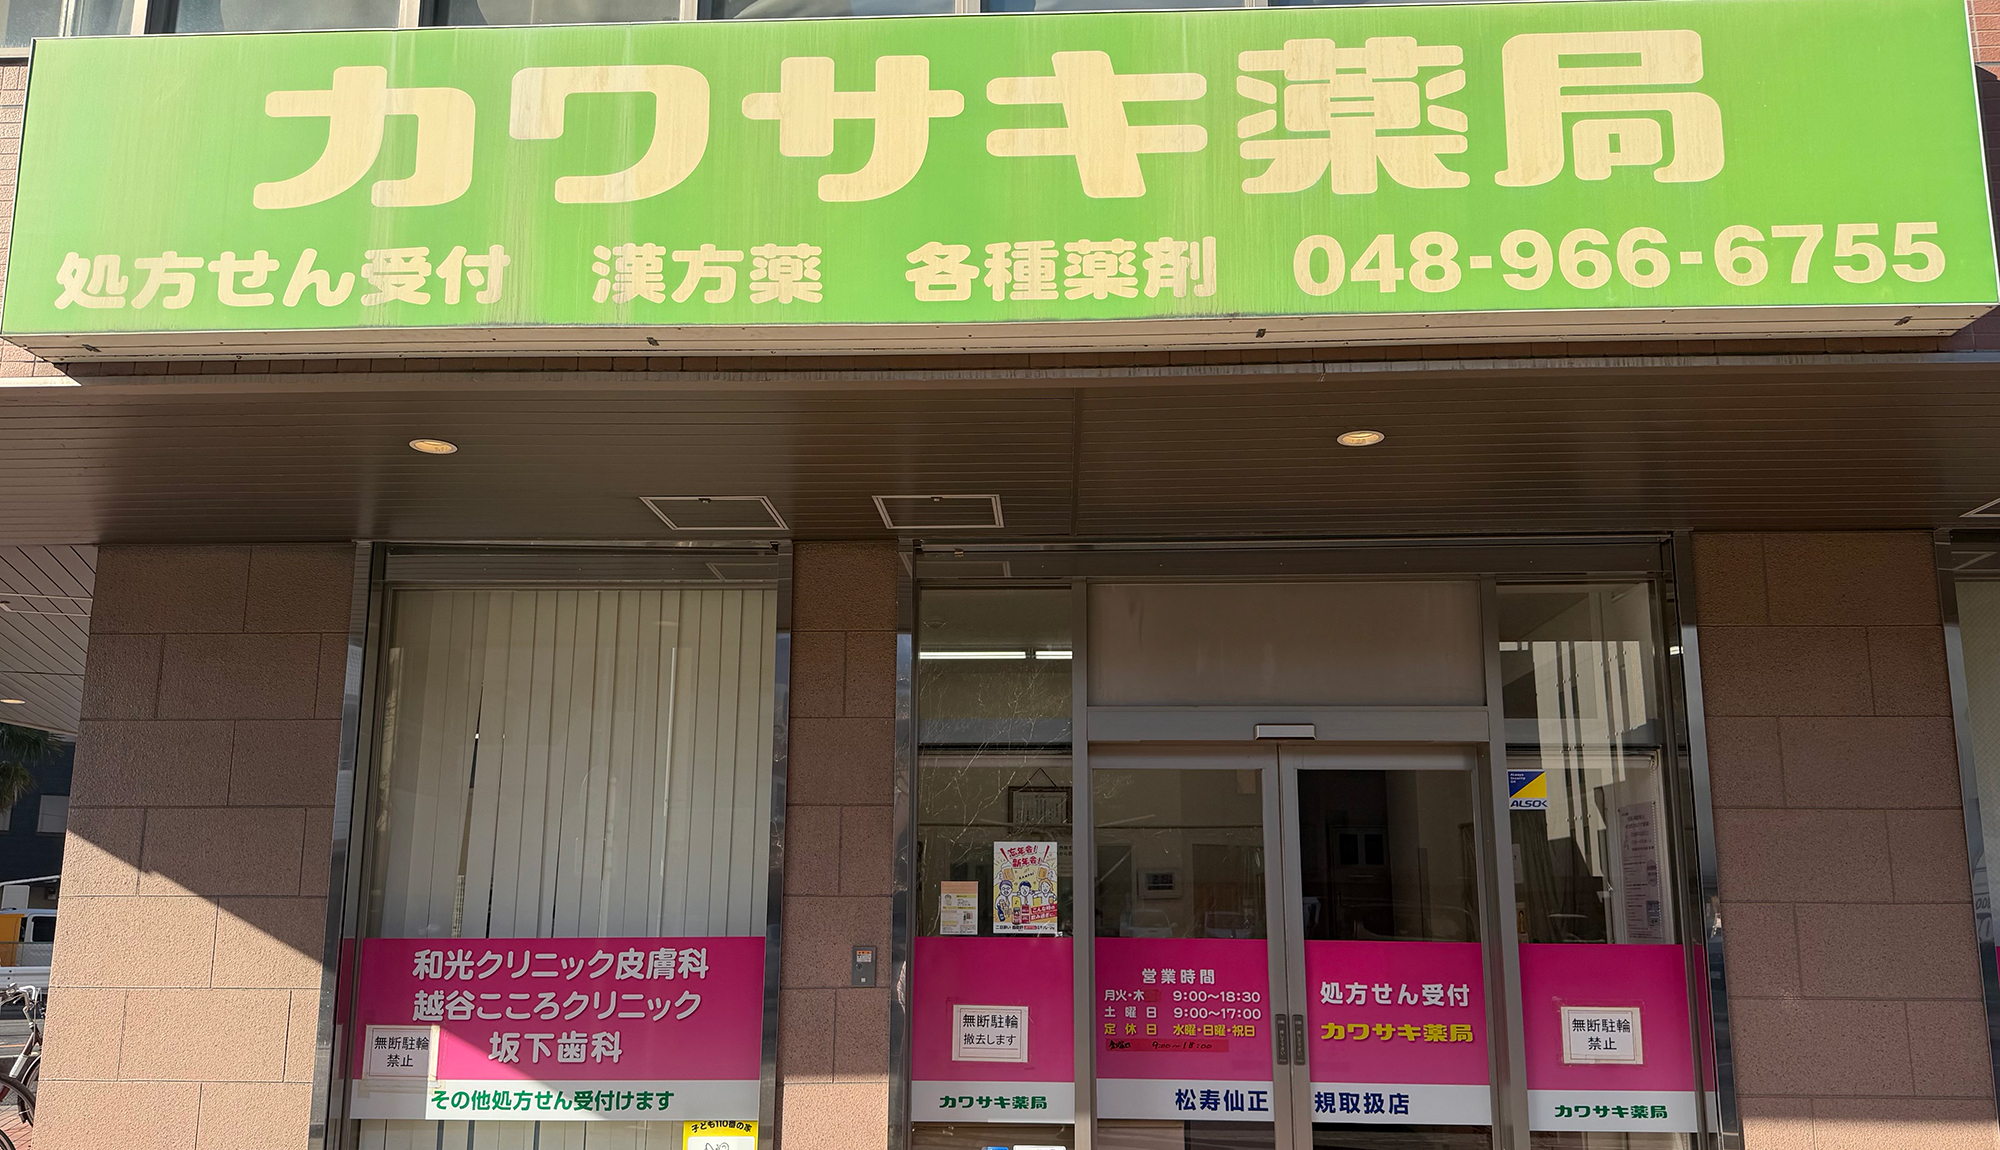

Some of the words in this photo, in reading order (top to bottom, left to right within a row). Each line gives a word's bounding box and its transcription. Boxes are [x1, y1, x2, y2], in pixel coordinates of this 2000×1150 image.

[254, 30, 1724, 210] カワサキ薬局
[55, 245, 511, 310] 処方せん受付
[592, 243, 822, 304] 漢方薬
[905, 236, 1217, 302] 各種薬剤
[1293, 221, 1946, 297] 048-966-6755
[412, 947, 709, 981] 和光クリニック皮膚科
[1141, 968, 1215, 985] 営業時間
[1320, 981, 1471, 1007] 処方せん受付
[412, 989, 702, 1022] 越谷こころクリニック
[1104, 1006, 1157, 1018] 土曜日
[962, 1013, 1019, 1029] 無断駐輪
[1571, 1018, 1631, 1033] 無断駐輪
[1104, 1023, 1157, 1035] 定休日
[1173, 1024, 1256, 1037] 水曜・日曜・祝日
[1320, 1022, 1474, 1042] カワサキ薬局
[374, 1036, 429, 1051] 無断駐輪
[488, 1030, 623, 1063] 坂下歯科
[963, 1033, 1016, 1046] 撤去します
[1588, 1036, 1617, 1051] 禁止
[386, 1054, 414, 1068] 禁止
[430, 1089, 675, 1112] その他処方せん受付けます
[938, 1095, 1048, 1110] カワサキ薬局
[1174, 1088, 1269, 1112] 松寿仙正
[1314, 1091, 1410, 1115] 規取扱店
[1554, 1104, 1668, 1119] カワサキ薬局
[691, 1120, 753, 1133] 子ども110番の家
